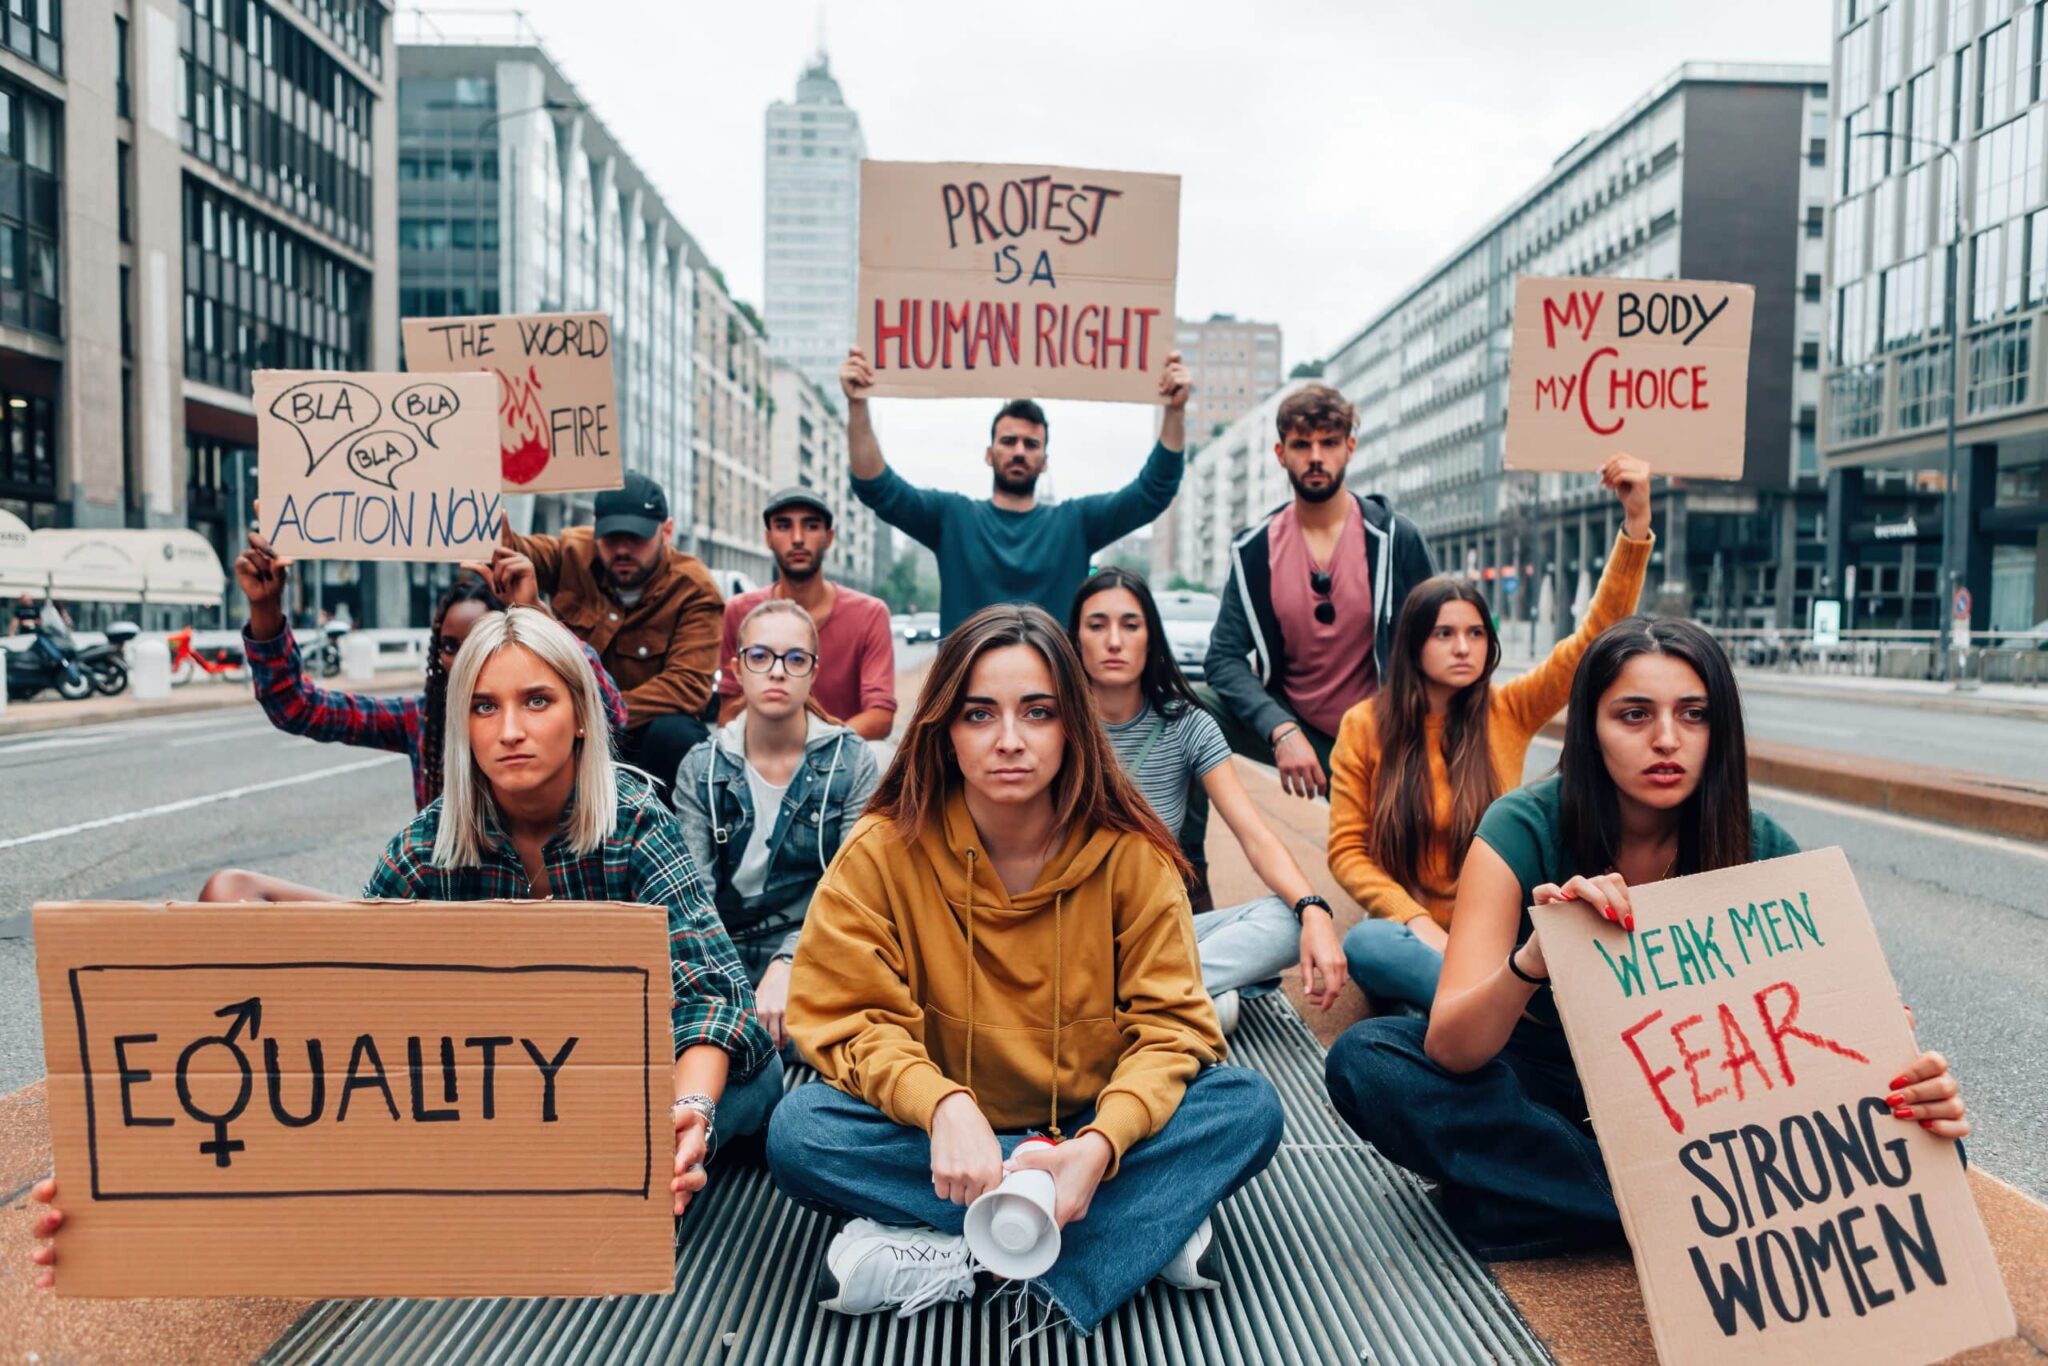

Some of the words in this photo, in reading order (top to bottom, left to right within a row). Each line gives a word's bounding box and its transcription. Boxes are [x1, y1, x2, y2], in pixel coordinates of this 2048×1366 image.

[941, 175, 1124, 249] PROTEST
[995, 245, 1023, 285] IS
[1029, 250, 1057, 289] A
[428, 322, 497, 361] THE
[518, 319, 609, 359] WORLD
[874, 298, 1021, 370] HUMAN
[1035, 302, 1161, 372] RIGHT
[1543, 291, 1605, 349] MY
[1618, 292, 1730, 347] BODY
[292, 388, 354, 424] BLA
[406, 393, 453, 417] BLA
[1536, 374, 1577, 412] MY
[1579, 346, 1710, 436] CHOICE
[355, 441, 403, 469] BLA
[550, 404, 611, 458] FIRE
[269, 491, 415, 547] ACTION
[427, 487, 502, 548] NOW
[1593, 915, 1736, 998] WEAK
[1728, 891, 1826, 965] MEN
[113, 997, 580, 1168] EQUALITY
[1621, 981, 1871, 1135] FEAR
[1678, 1096, 1912, 1238] STRONG
[1687, 1193, 1948, 1337] WOMEN
